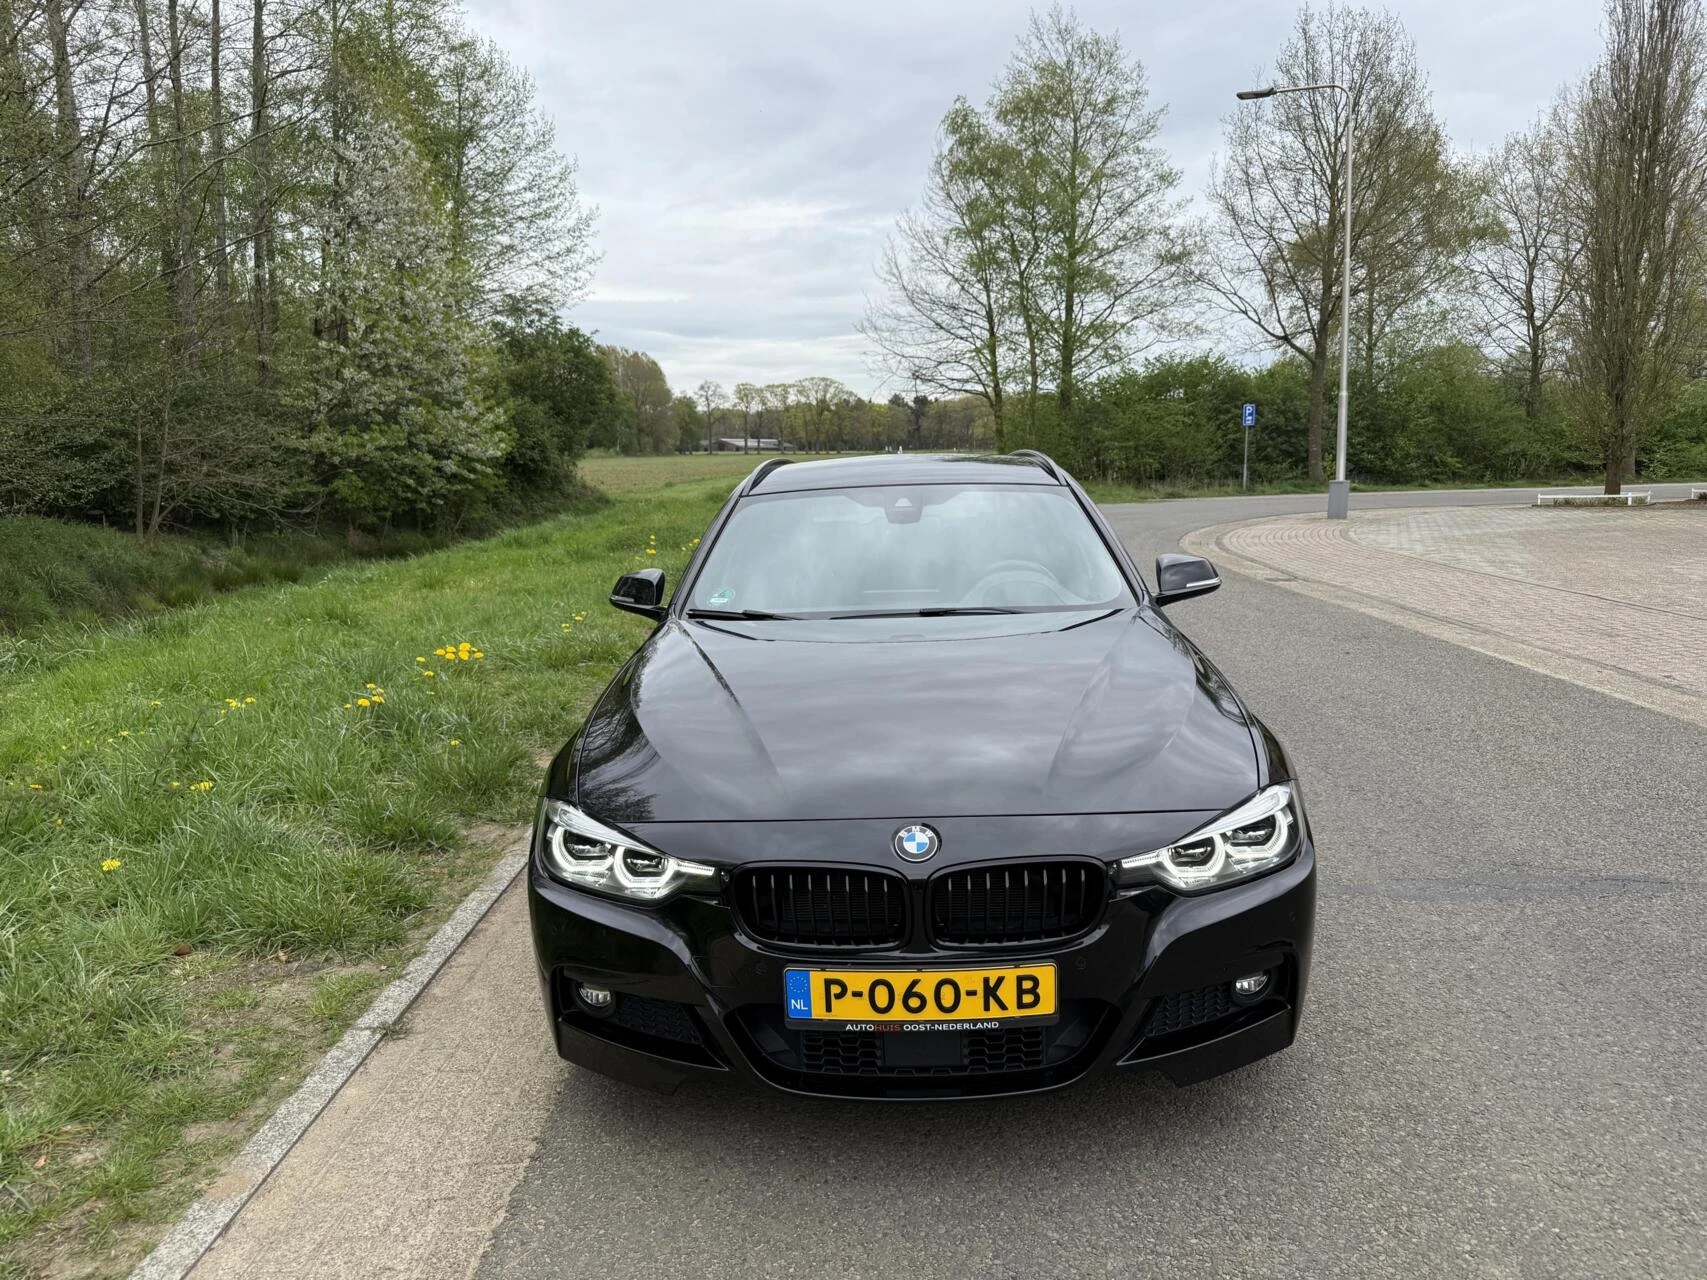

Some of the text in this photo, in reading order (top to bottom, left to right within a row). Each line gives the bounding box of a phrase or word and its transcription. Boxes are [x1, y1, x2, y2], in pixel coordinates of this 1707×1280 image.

[1246, 406, 1253, 416] P
[823, 974, 1041, 1015] P-060-KB
[791, 999, 808, 1010] NL
[845, 1021, 999, 1032] AUTOHUIS OOST-NEDERLAND
